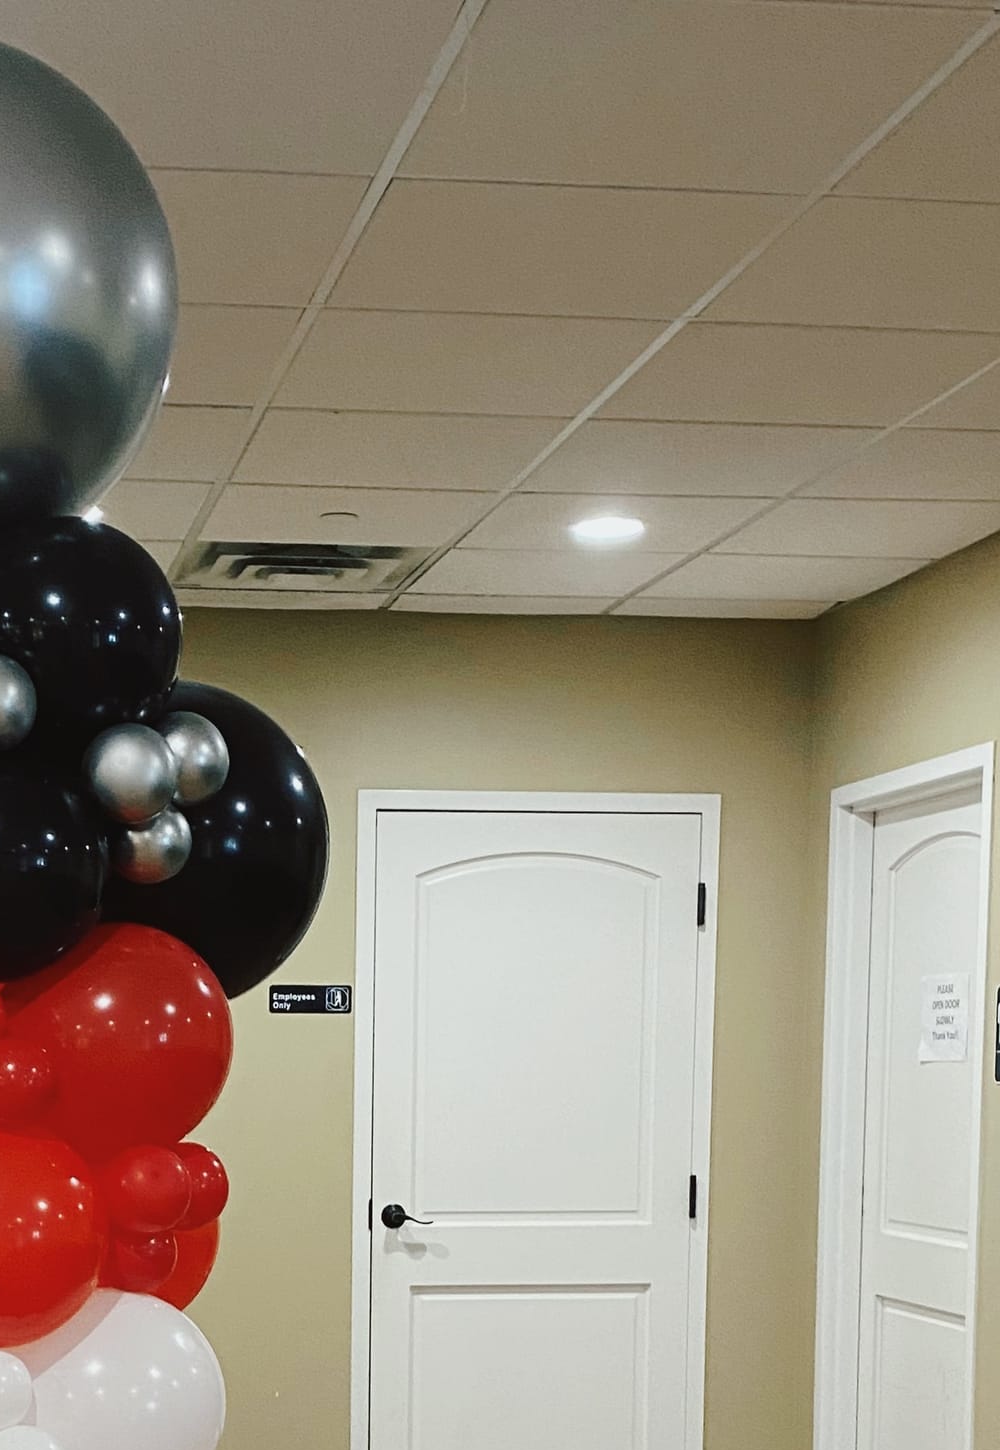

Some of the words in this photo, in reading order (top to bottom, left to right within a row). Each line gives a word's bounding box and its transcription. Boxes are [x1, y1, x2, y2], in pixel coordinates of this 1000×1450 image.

[272, 993, 316, 1001] Employees
[272, 1002, 291, 1011] Only
[945, 999, 960, 1009] DOOR
